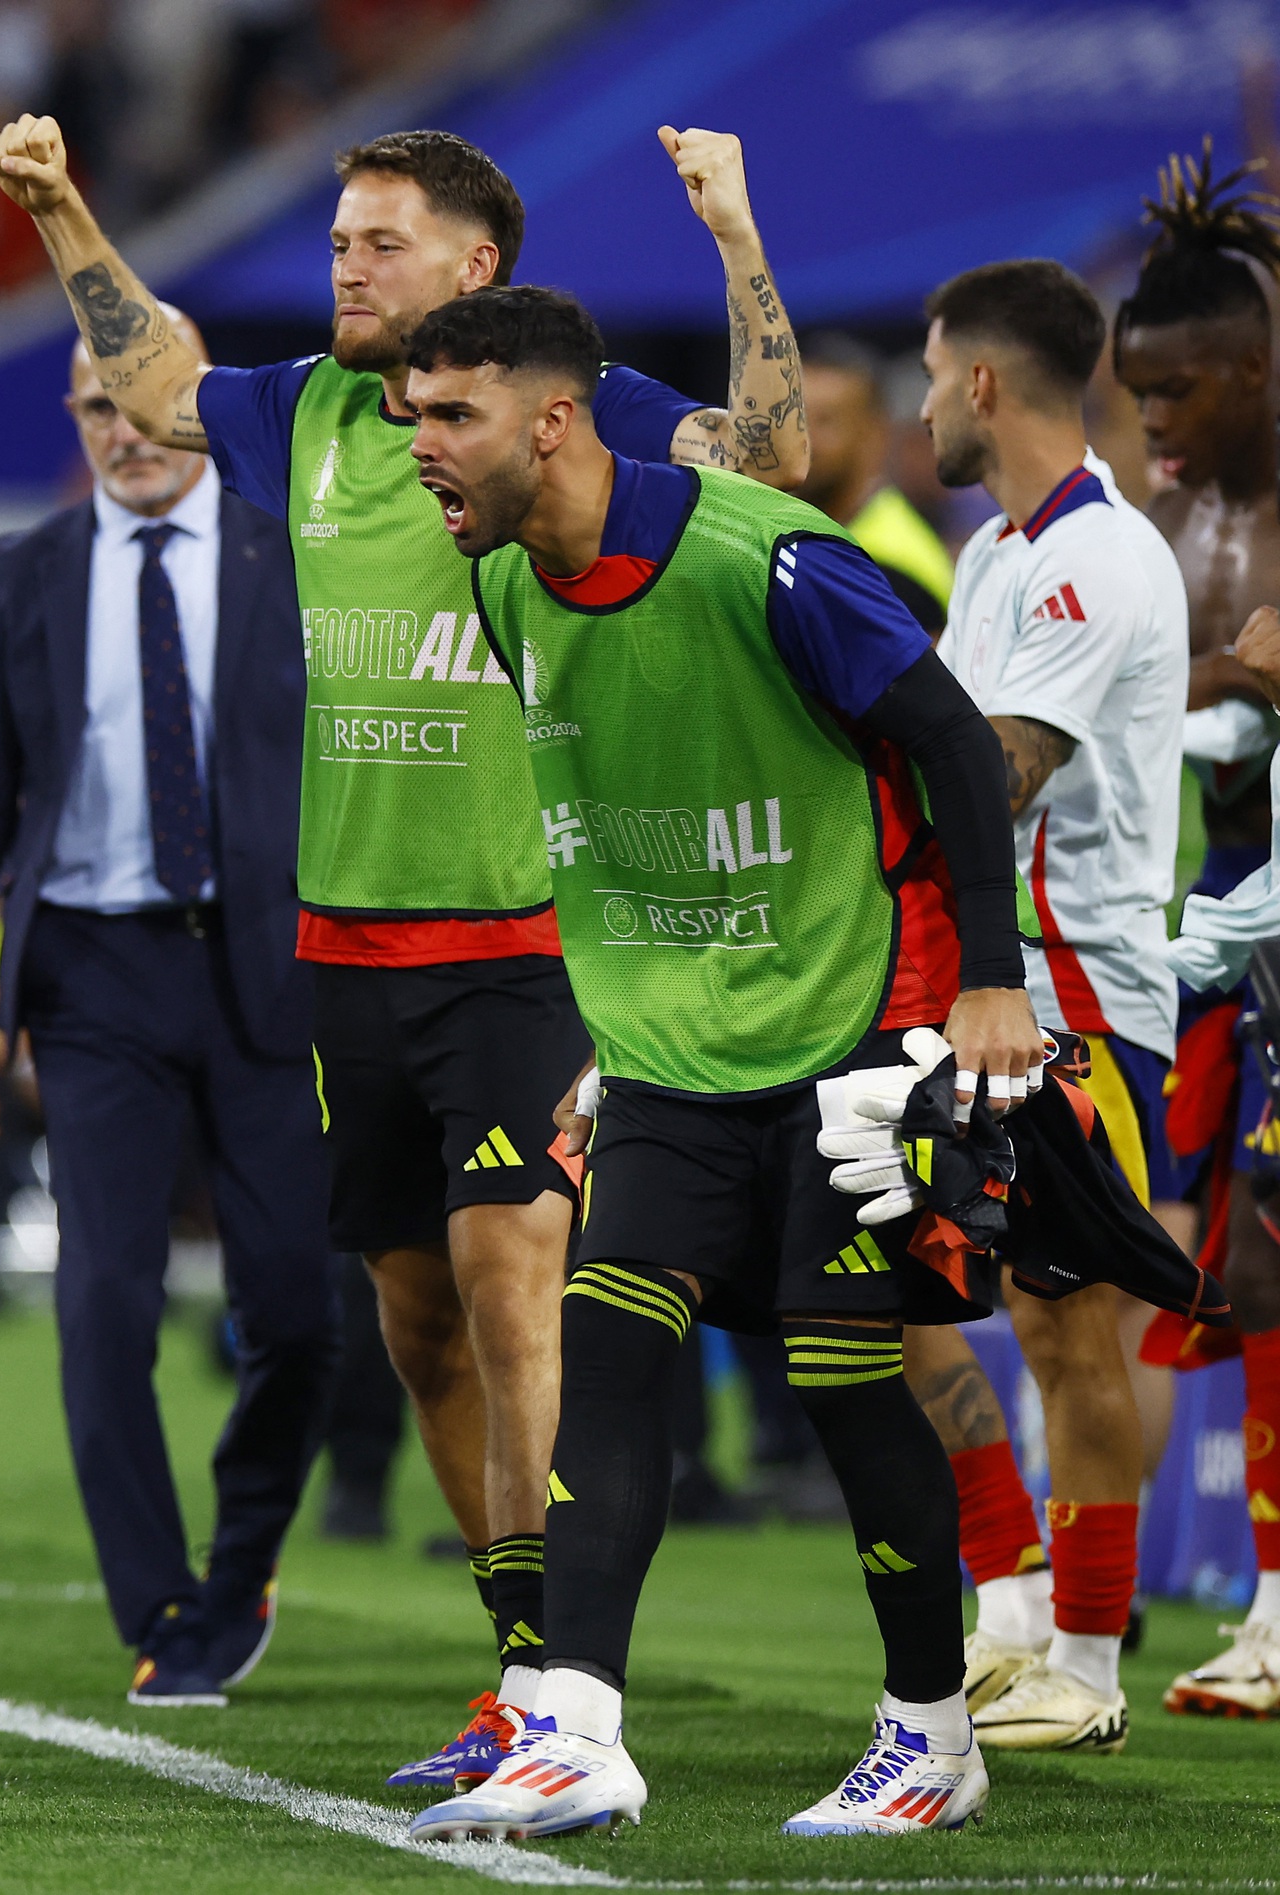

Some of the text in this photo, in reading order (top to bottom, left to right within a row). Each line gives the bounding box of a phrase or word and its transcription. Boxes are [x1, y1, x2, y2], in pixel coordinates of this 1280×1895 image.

[334, 719, 467, 753] RESPECT
[525, 722, 582, 742] RO2024
[541, 797, 793, 874] #FOOTBALL
[544, 1749, 607, 1773] F50
[915, 1772, 966, 1787] F50
